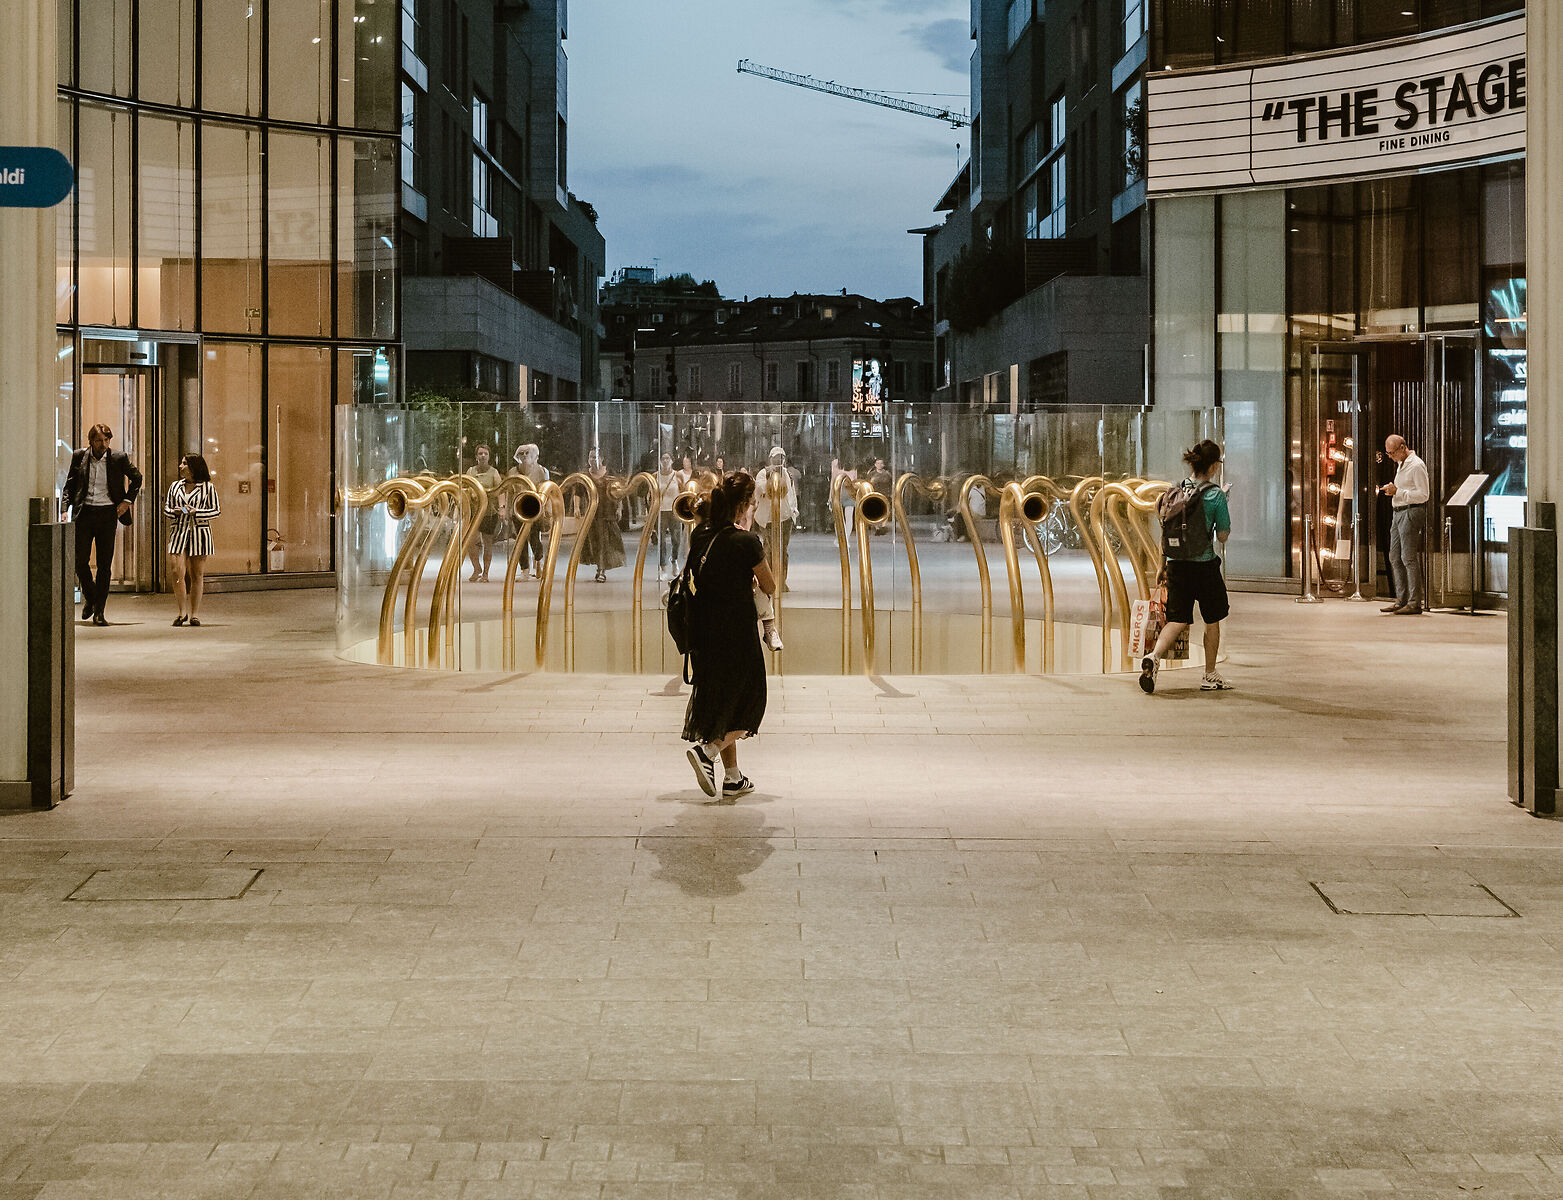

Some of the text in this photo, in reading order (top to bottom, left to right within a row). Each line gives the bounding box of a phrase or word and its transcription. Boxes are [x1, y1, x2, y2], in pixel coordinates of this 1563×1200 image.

[1394, 57, 1526, 131] STAGE
[1379, 130, 1450, 152] FINE DINING
[1132, 604, 1145, 654] MIGROS
